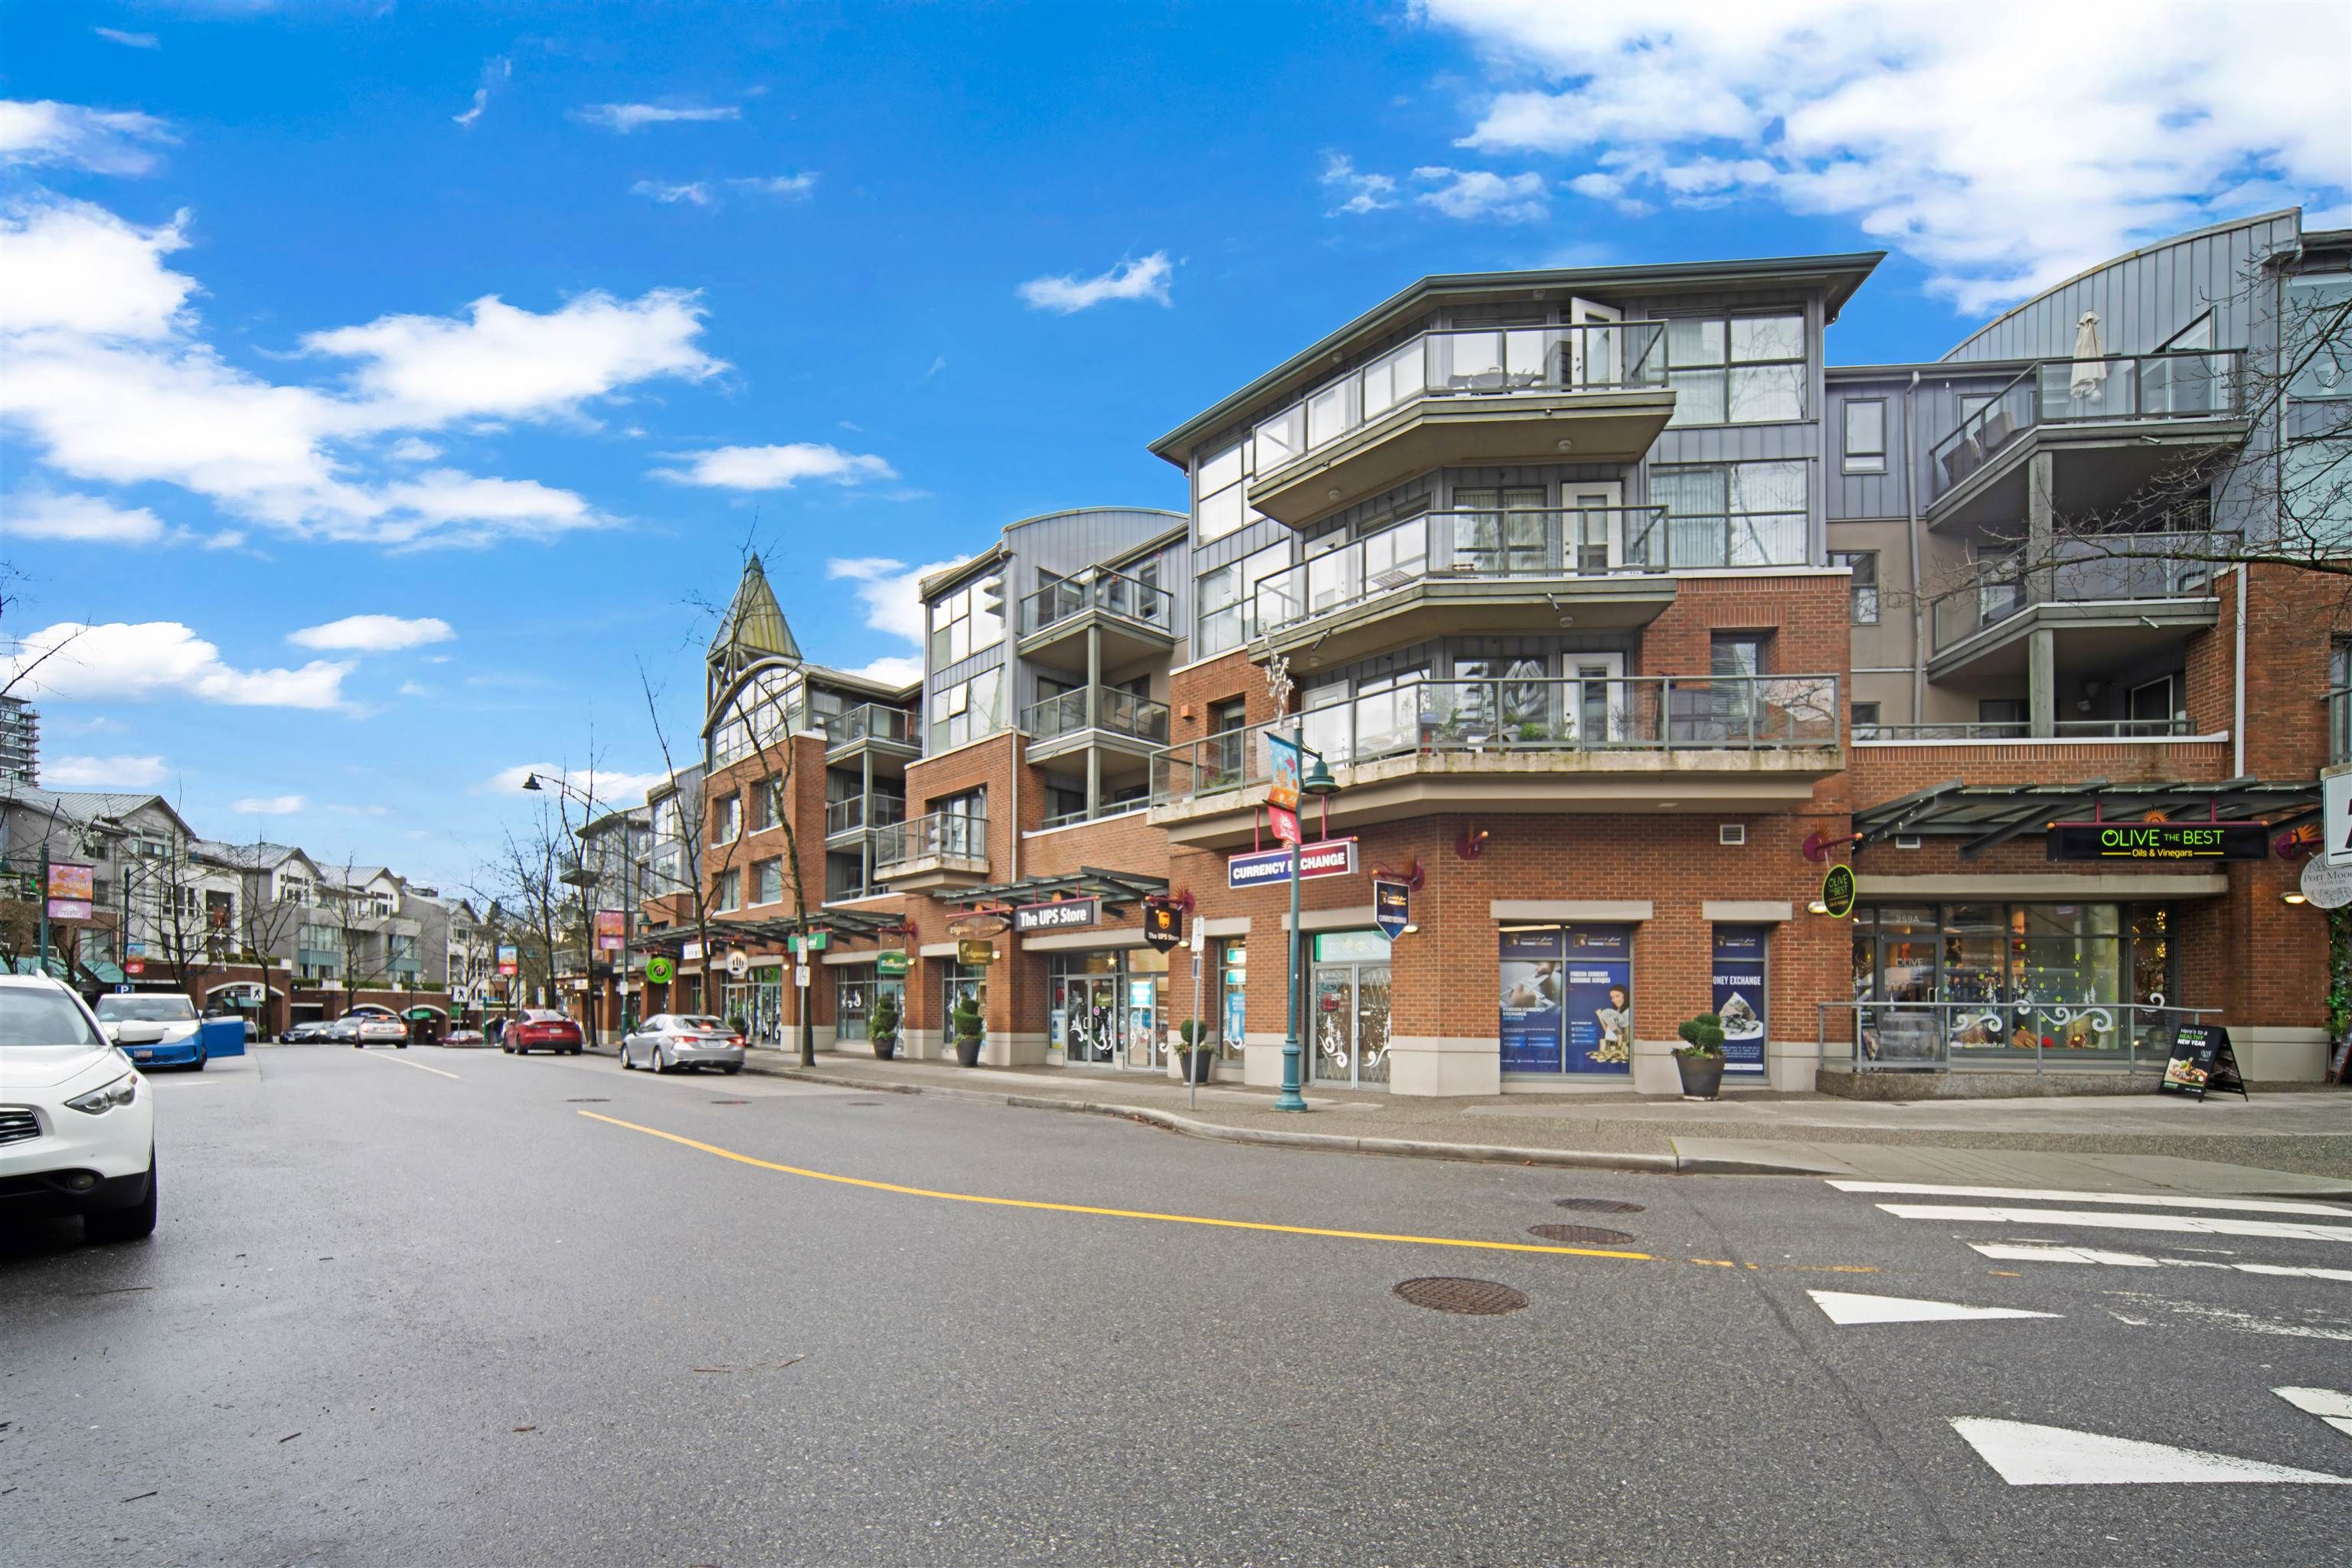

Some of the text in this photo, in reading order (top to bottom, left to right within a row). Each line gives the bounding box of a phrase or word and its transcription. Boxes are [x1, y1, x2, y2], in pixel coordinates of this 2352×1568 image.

[2102, 829, 2160, 846] OLIVE
[2184, 831, 2224, 844] BEST
[2157, 848, 2193, 858] Vinegars
[1233, 852, 1345, 880] CURRENCY ECHANGE
[1828, 874, 1847, 888] OLIVE
[2304, 874, 2323, 883] Port
[1834, 885, 1847, 896] BEST
[1020, 907, 1087, 927] The UPS Store
[1896, 958, 1923, 968] OLIVE
[1713, 975, 1761, 985] ONEY EXCHANGE
